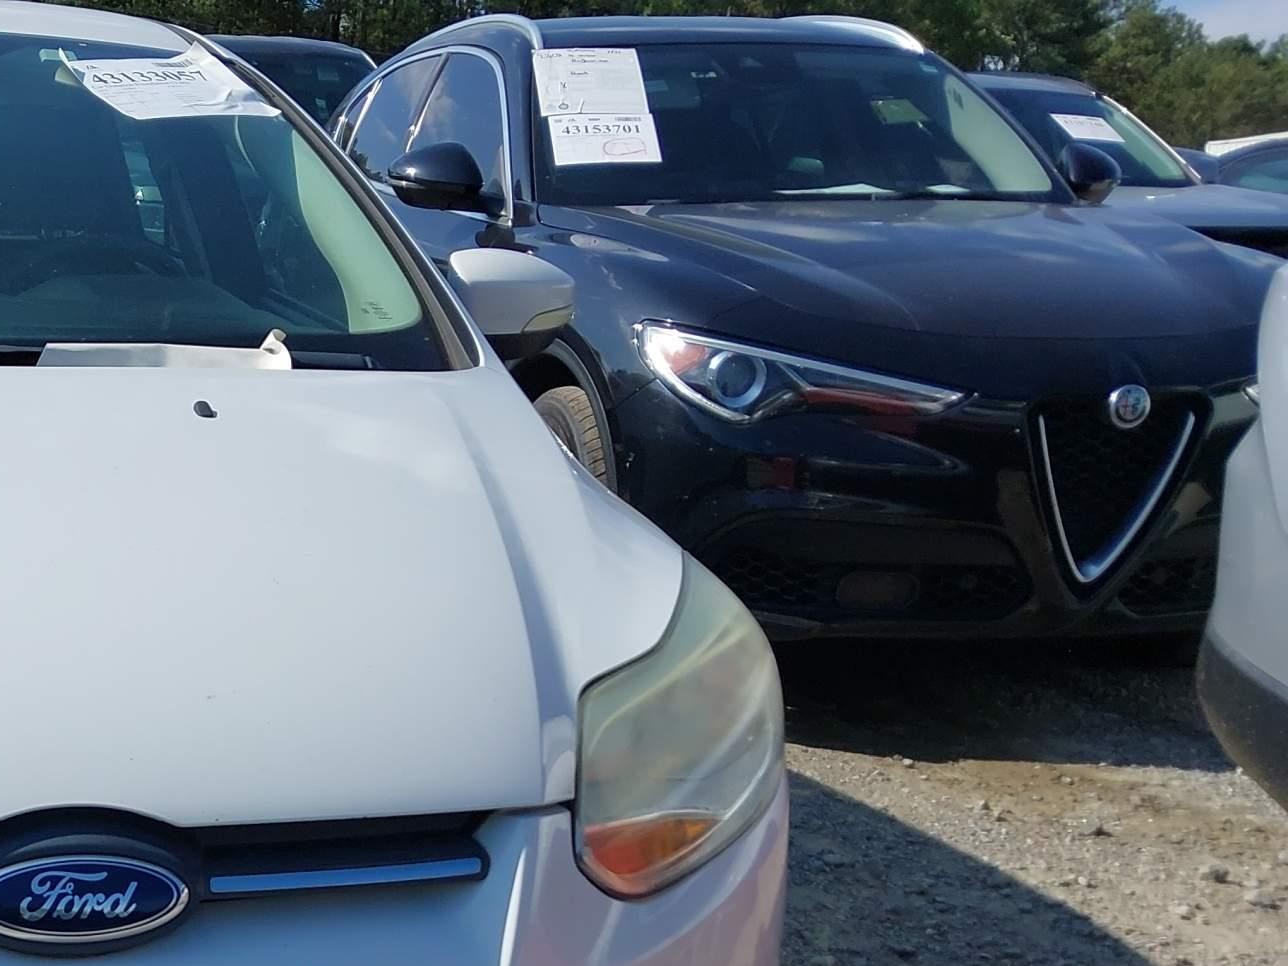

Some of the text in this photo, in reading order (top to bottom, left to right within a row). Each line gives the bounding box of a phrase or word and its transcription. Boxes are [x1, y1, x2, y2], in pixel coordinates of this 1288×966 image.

[92, 70, 209, 85] 43133057
[561, 124, 641, 135] 43153701
[19, 870, 138, 922] Ford
